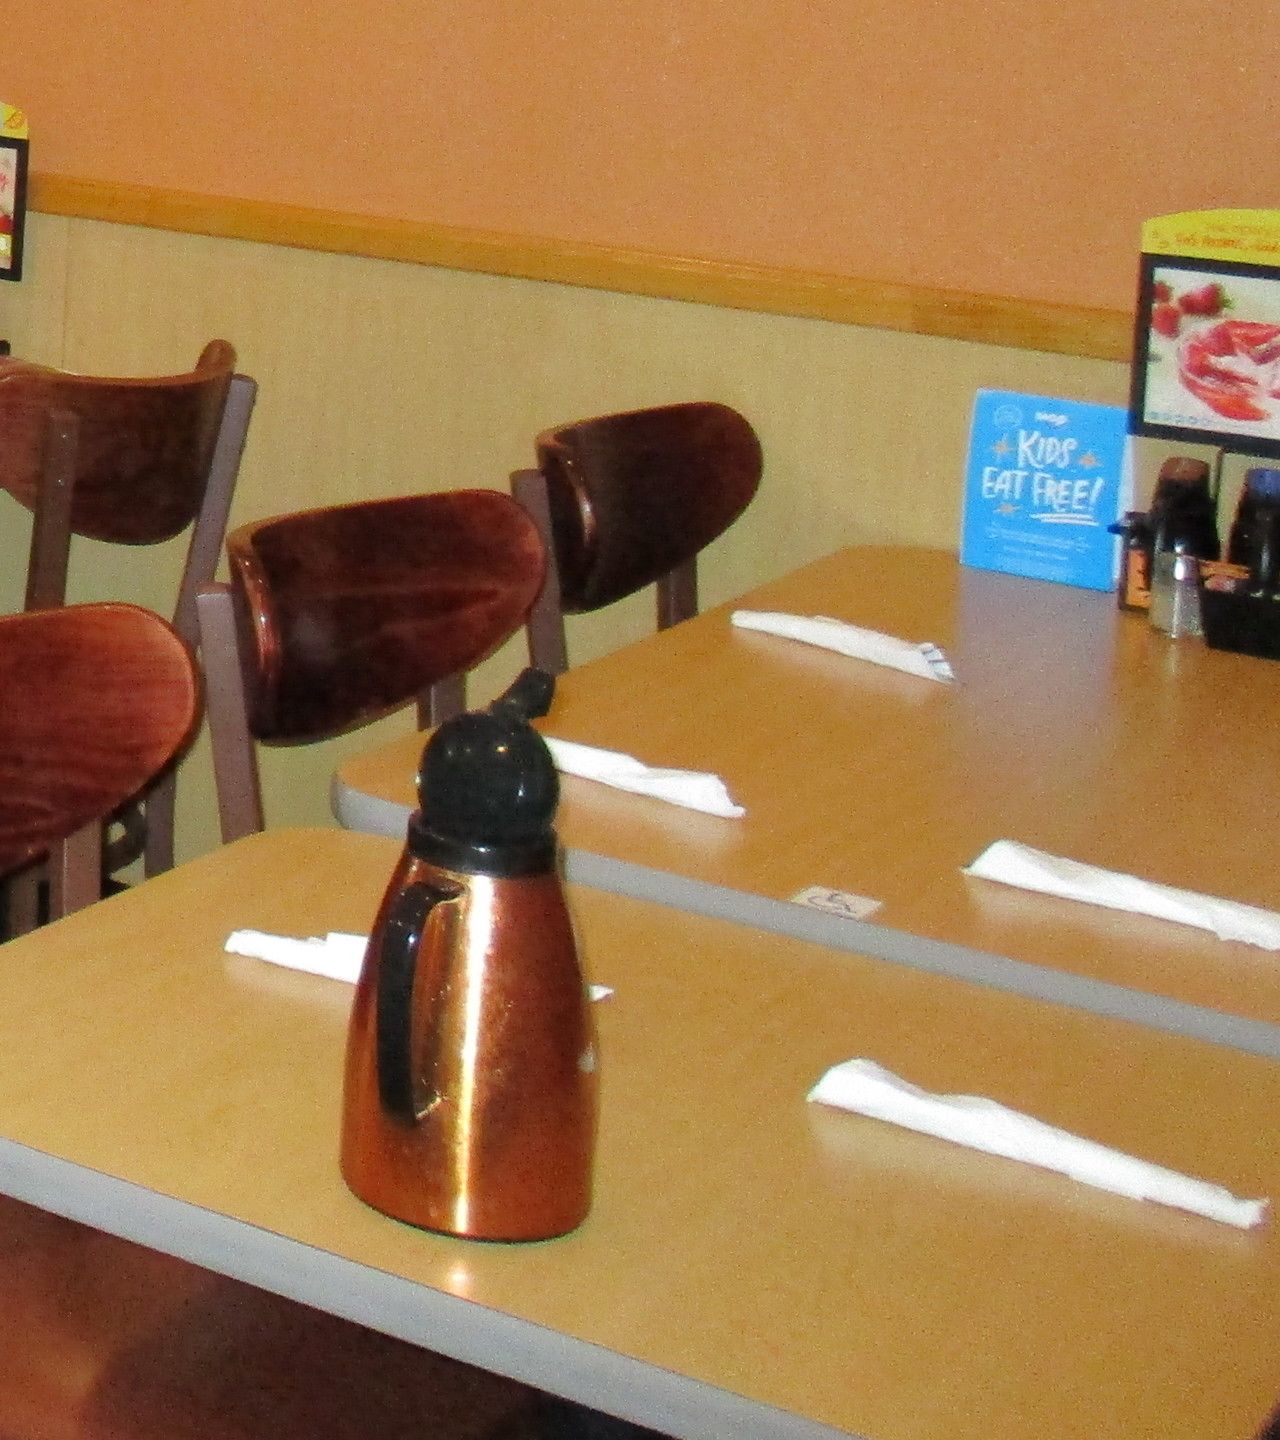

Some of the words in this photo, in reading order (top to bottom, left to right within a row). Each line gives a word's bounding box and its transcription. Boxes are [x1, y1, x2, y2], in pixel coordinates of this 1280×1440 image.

[1017, 429, 1079, 469] KIDS
[982, 466, 1029, 500] EAT
[1032, 471, 1105, 513] FREE!
